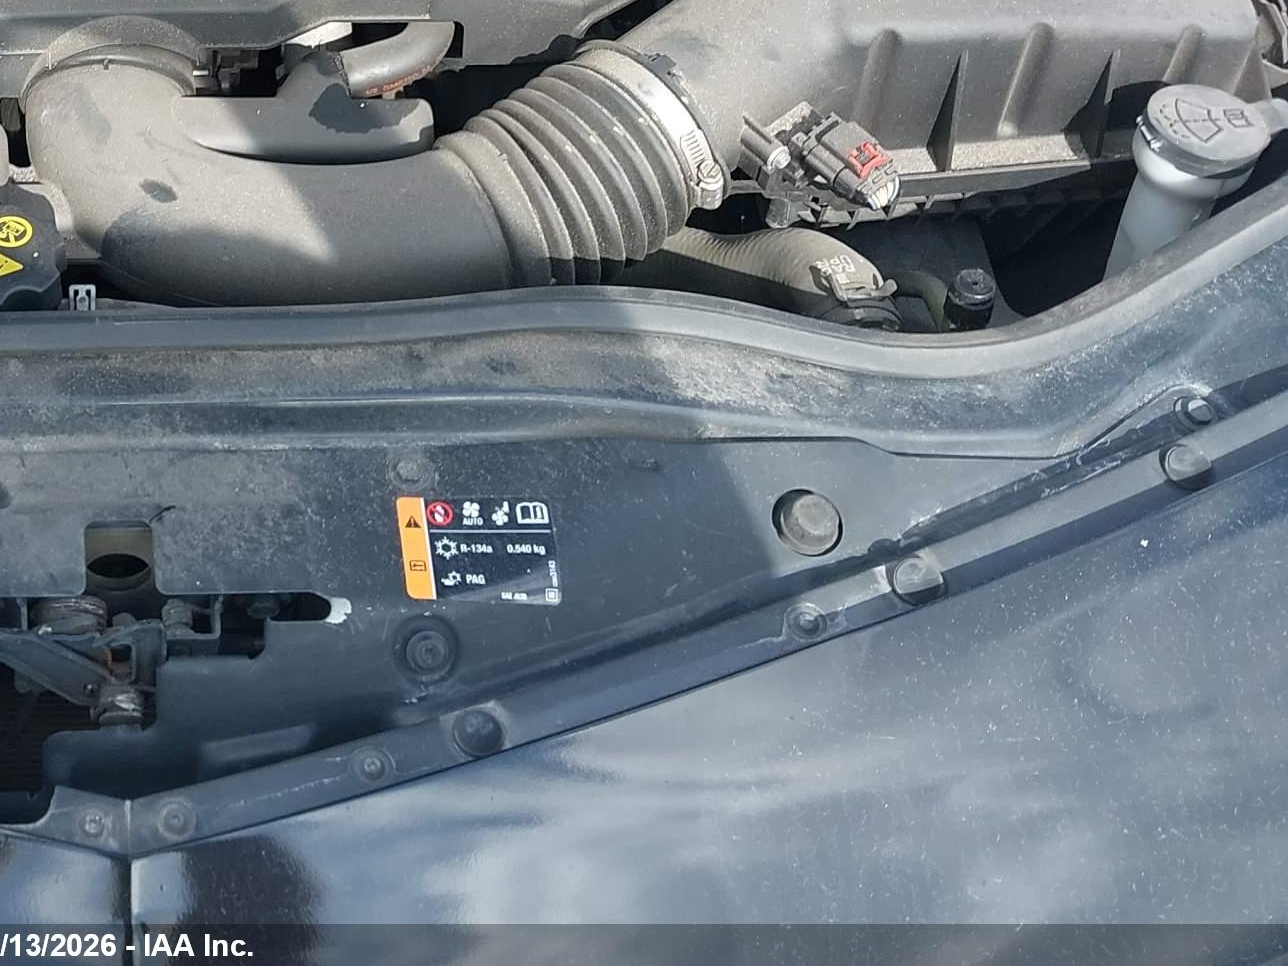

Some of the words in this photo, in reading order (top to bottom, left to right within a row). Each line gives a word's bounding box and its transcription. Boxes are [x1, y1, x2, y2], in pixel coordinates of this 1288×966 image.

[462, 517, 484, 527] AUTO
[459, 543, 494, 554] R-134a
[506, 543, 532, 554] 0.540
[532, 544, 546, 556] kg
[465, 573, 487, 585] PAG
